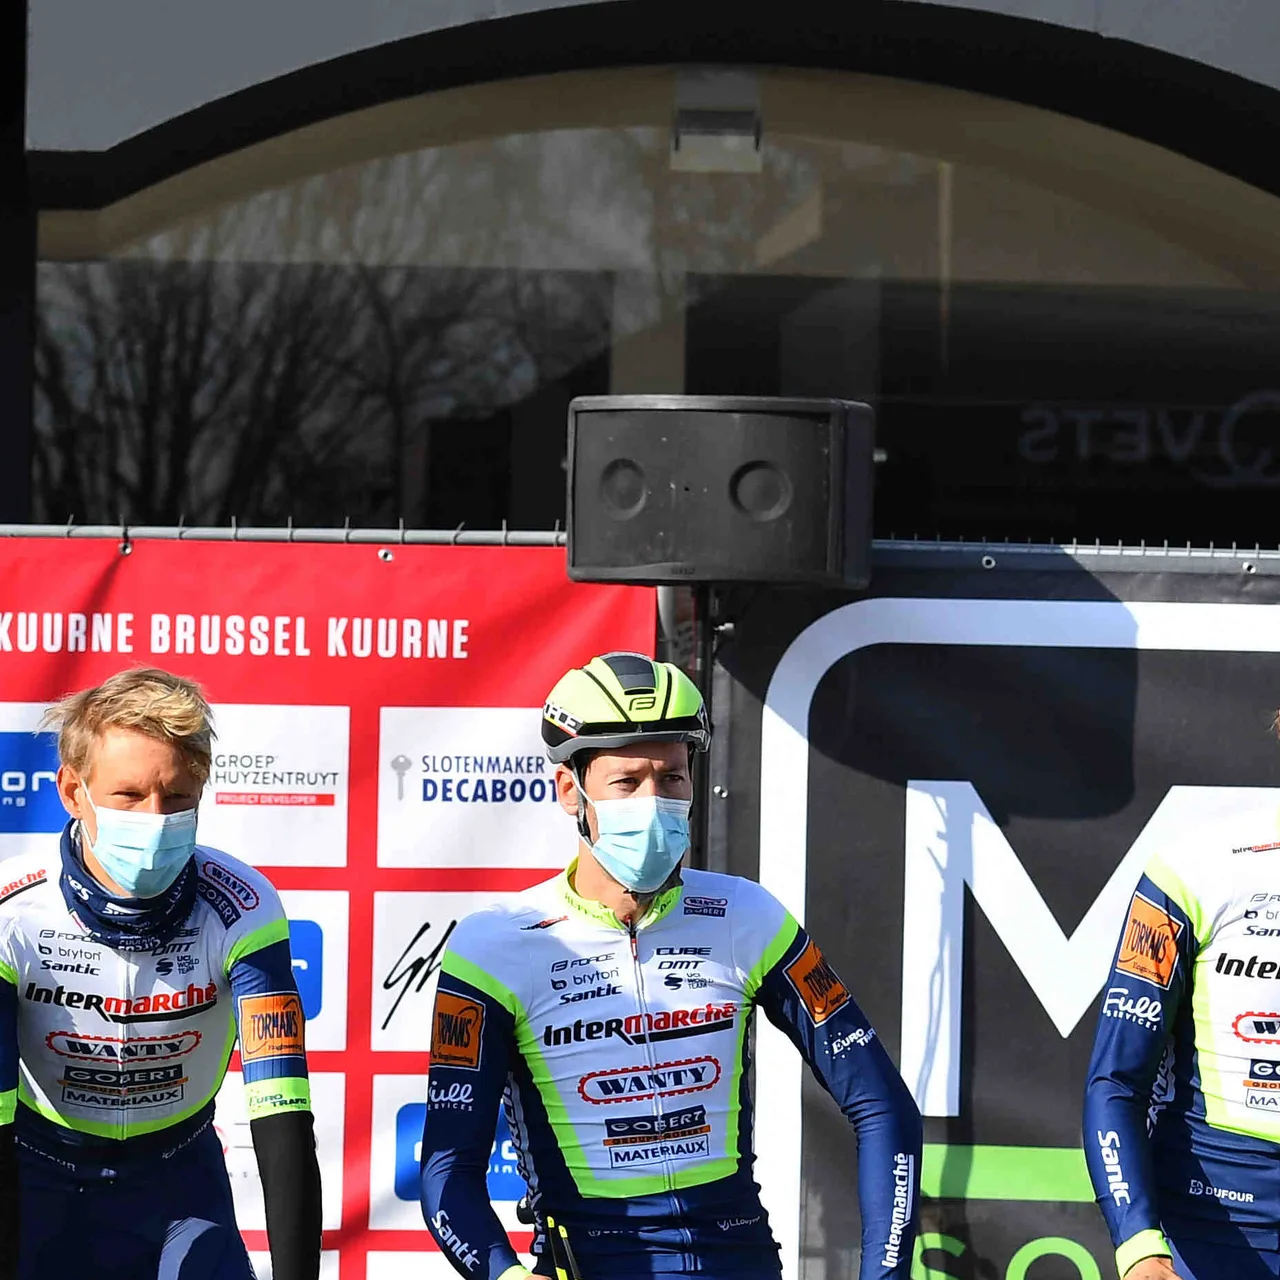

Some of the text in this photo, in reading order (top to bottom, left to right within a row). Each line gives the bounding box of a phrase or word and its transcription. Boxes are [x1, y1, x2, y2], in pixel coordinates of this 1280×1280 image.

[150, 614, 310, 657] BRUSSEL
[327, 618, 471, 660] KUURNE
[214, 755, 275, 768] GROEP
[422, 755, 545, 774] SLOTENMAKER
[215, 771, 339, 786] HUYZENTRUYT
[422, 777, 557, 803] DECABOOT
[212, 866, 254, 903] WANTY
[199, 881, 241, 925] GOBERT
[656, 947, 712, 956] CUBE
[1126, 919, 1170, 964] TORMANS
[58, 946, 102, 961] bryton
[570, 952, 616, 969] FORCE
[40, 959, 102, 977] Santic
[178, 966, 196, 974] TEAM
[658, 960, 705, 970] DMT
[573, 967, 619, 986] bryton
[24, 979, 218, 1022] Intermarché
[559, 983, 623, 1006] Santic
[1104, 988, 1163, 1022] Full
[250, 1010, 298, 1040] TORMANS
[544, 1002, 738, 1046] Intermarché
[1106, 1009, 1158, 1031] SERVICES
[65, 1039, 185, 1058] WANTY
[832, 1028, 865, 1054] EURO
[70, 1067, 178, 1085] GOBERT
[596, 1066, 707, 1096] WANTY
[66, 1089, 181, 1107] MATERIAUX
[610, 1110, 702, 1132] GOBERT
[613, 1139, 706, 1163] MATERIAUX
[1205, 1186, 1254, 1203] DUFOUR
[882, 1153, 910, 1268] Intermarché
[431, 1209, 481, 1273] Santic
